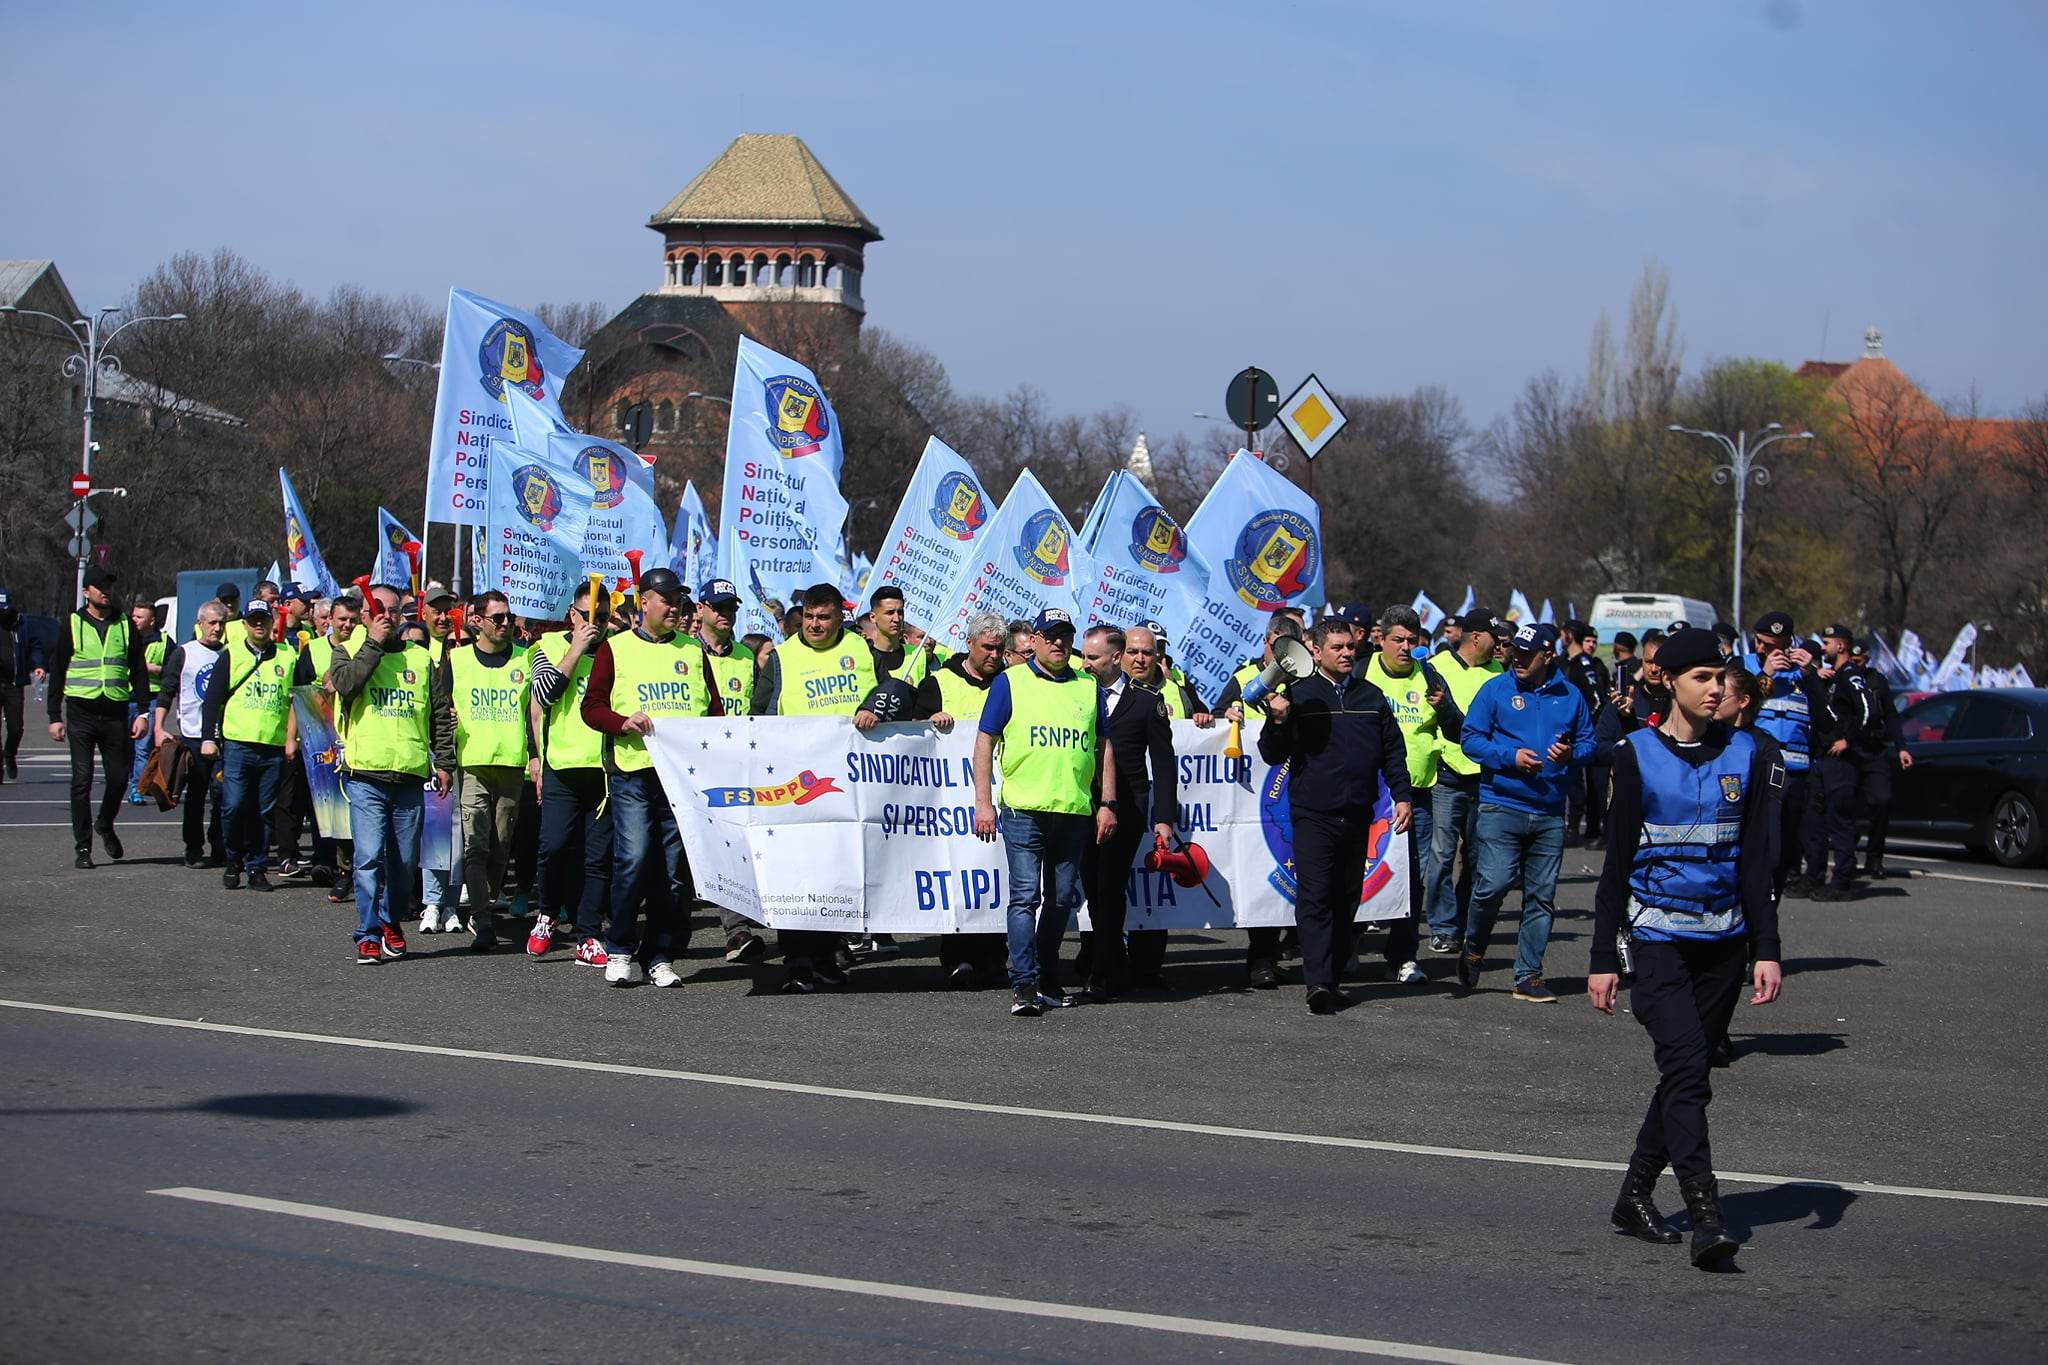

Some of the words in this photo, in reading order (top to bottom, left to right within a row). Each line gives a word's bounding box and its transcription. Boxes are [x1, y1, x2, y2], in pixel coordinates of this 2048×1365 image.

[616, 534, 625, 544] al
[1282, 513, 1314, 540] POLICE
[1104, 565, 1167, 599] Sindicatul
[1098, 581, 1149, 608] Național
[1150, 604, 1163, 616] al
[1605, 608, 1673, 619] BRIDGESTONE
[370, 687, 415, 708] SNPPC
[471, 688, 518, 707] SNPPC
[638, 682, 690, 702] SNPPC
[805, 673, 858, 698] SNPPC
[1030, 725, 1088, 752] FSNPPC
[847, 752, 957, 788] SINDICATUL
[724, 771, 816, 804] FSNPPC
[882, 804, 899, 840] ȘI
[915, 870, 952, 911] BT
[961, 869, 1001, 910] IPJ
